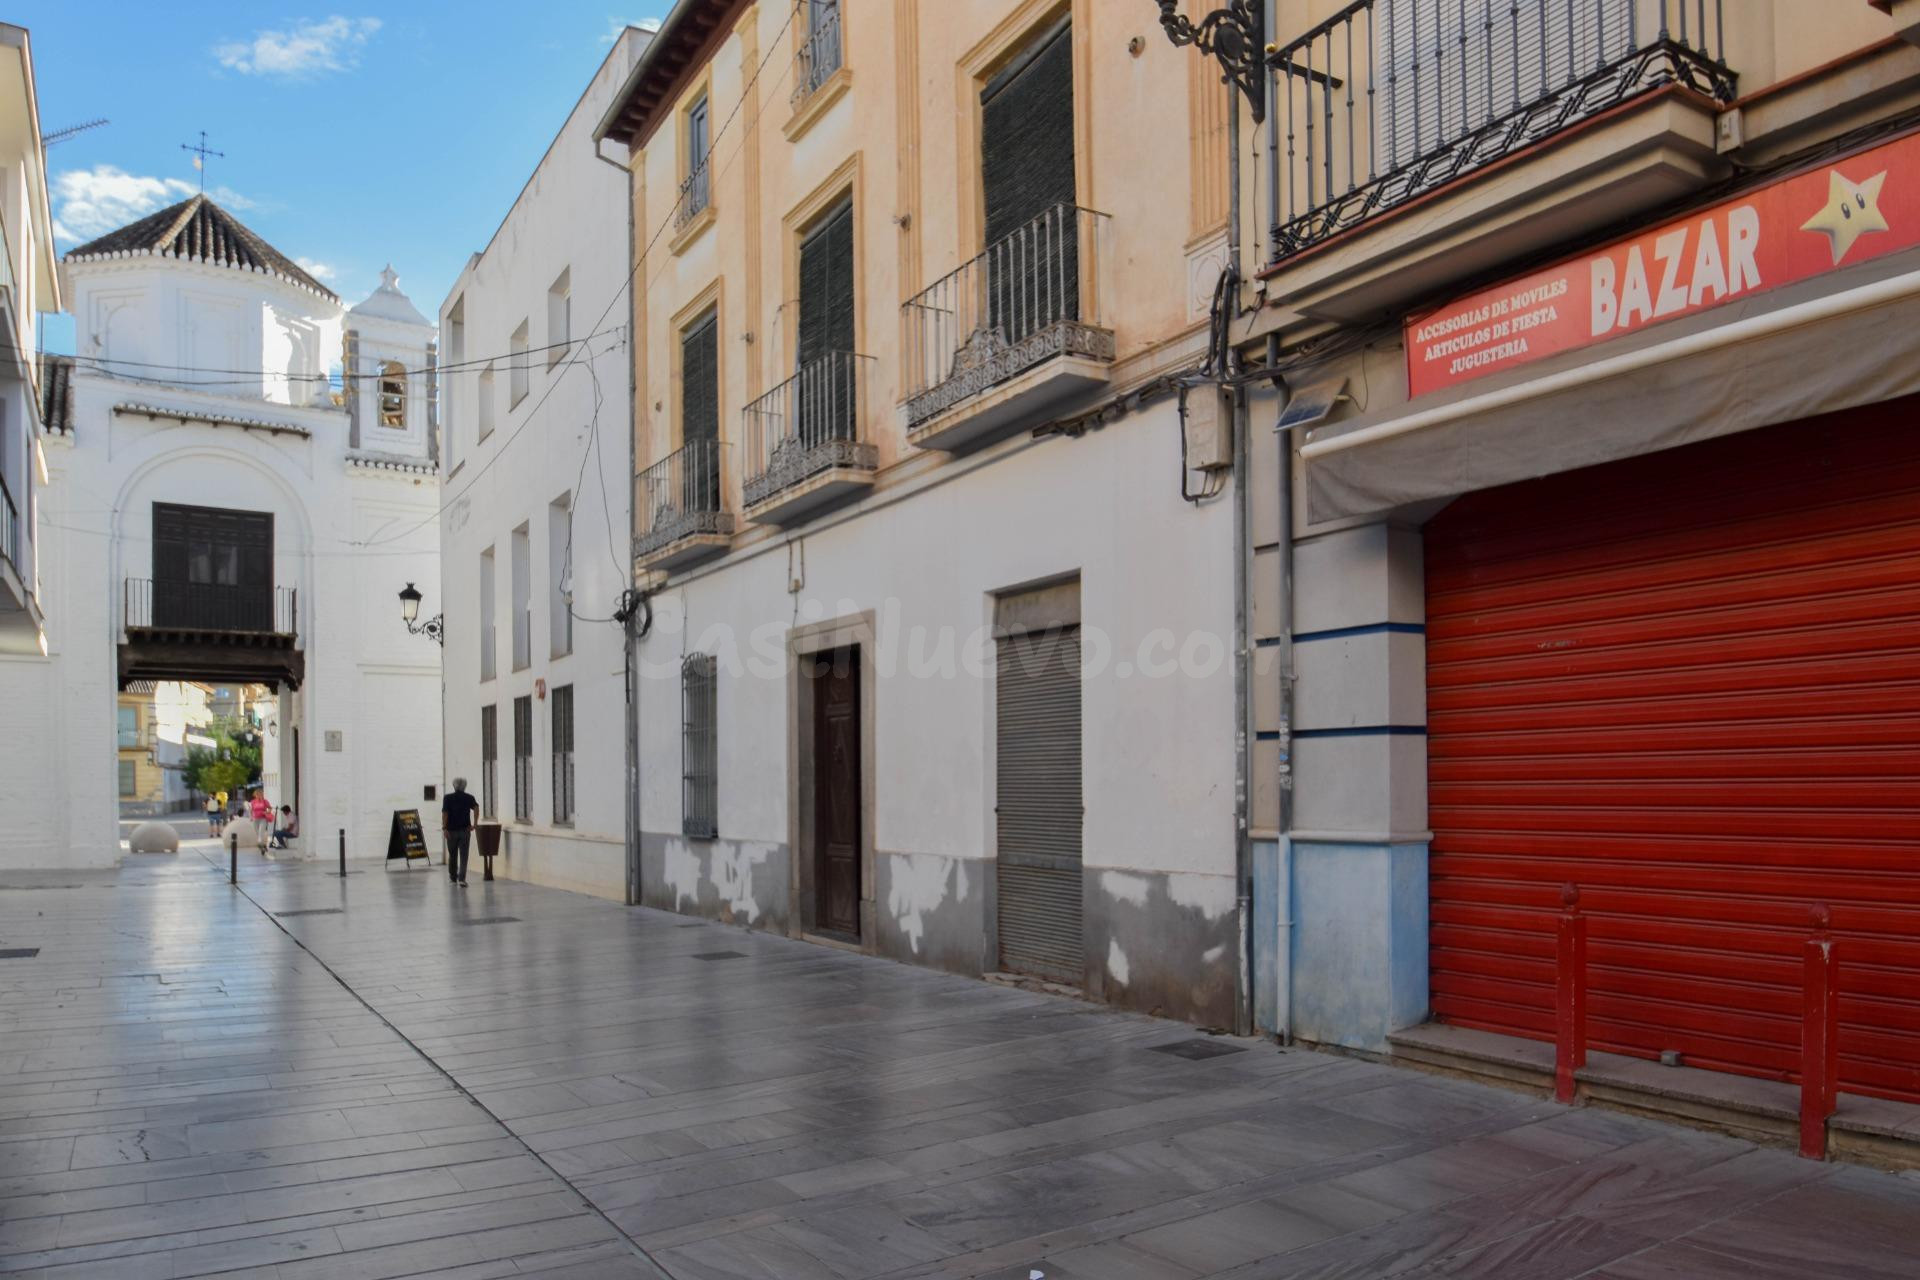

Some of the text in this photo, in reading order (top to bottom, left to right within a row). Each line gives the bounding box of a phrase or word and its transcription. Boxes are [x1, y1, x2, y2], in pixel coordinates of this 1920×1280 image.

[1590, 206, 1761, 337] BAZAR
[1416, 278, 1568, 343] ACCESORIAS DE MOVILES
[1424, 305, 1558, 362] ARTICULOS DE FIESTA
[1449, 337, 1528, 375] JUGUETERIA
